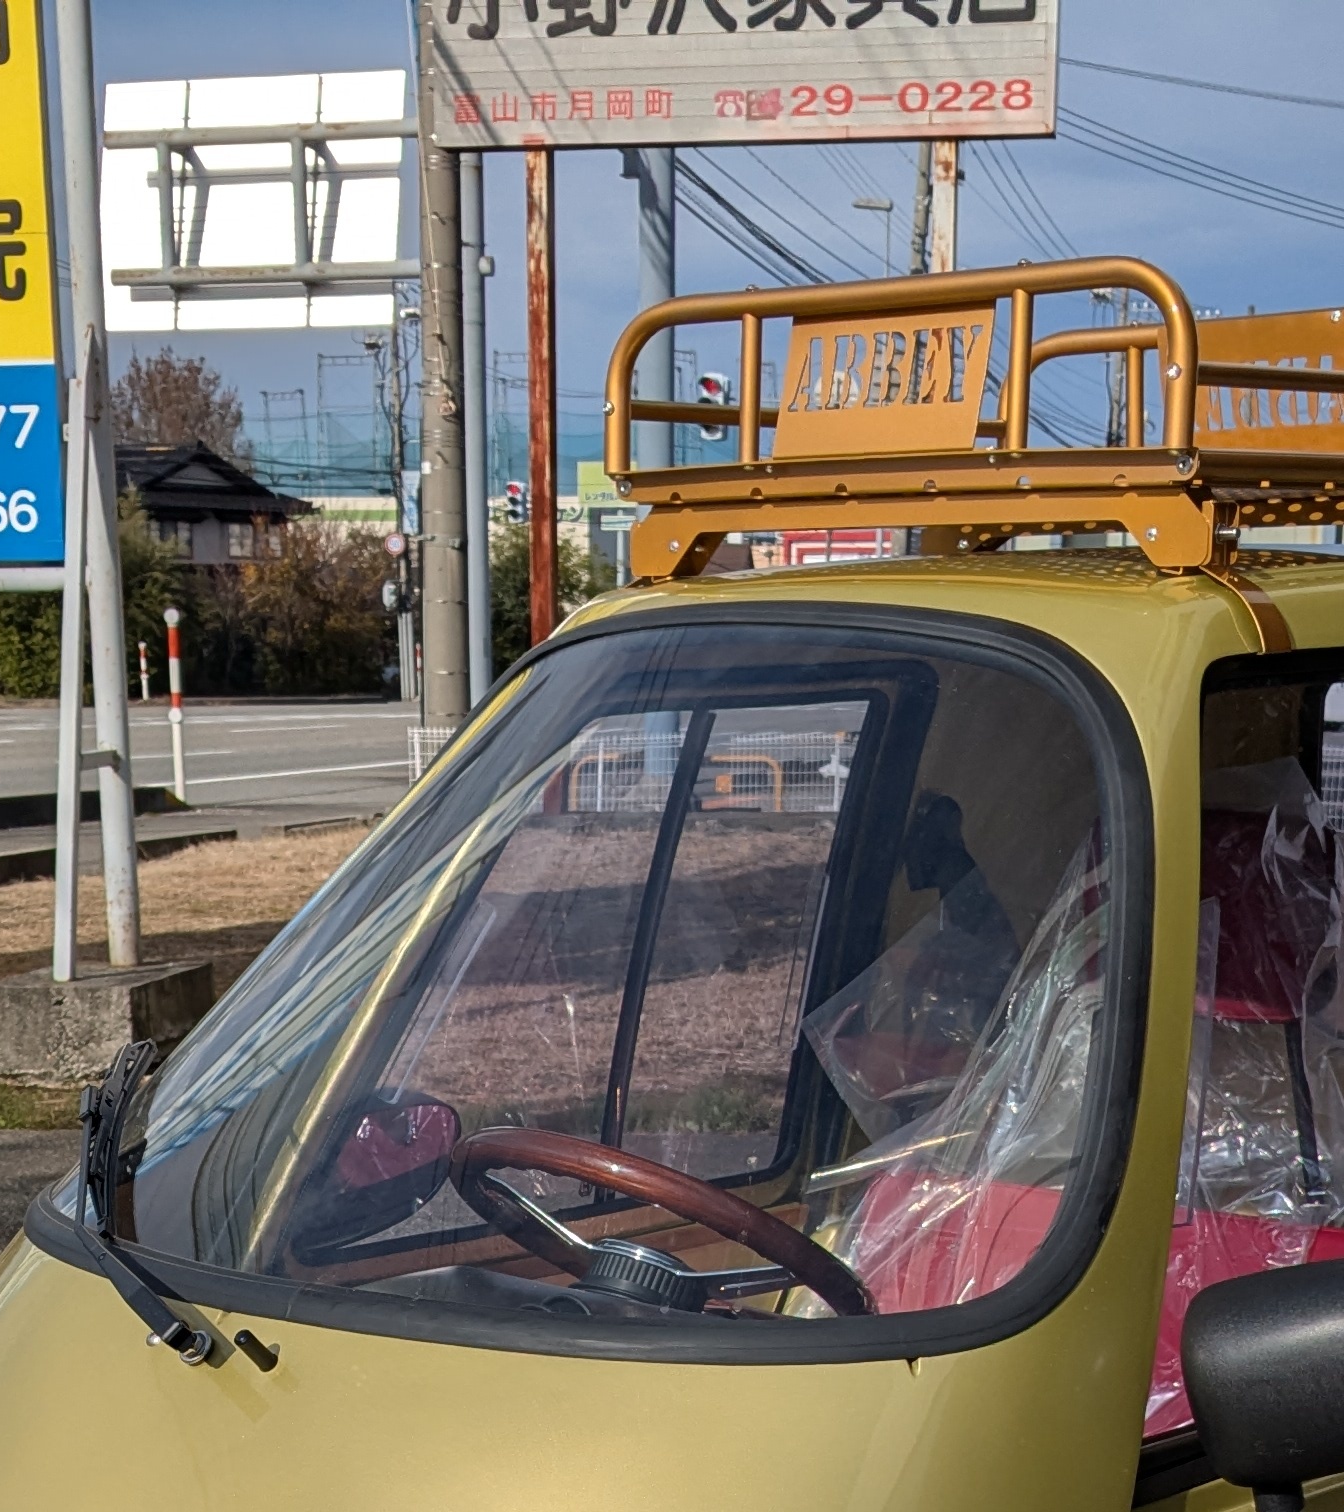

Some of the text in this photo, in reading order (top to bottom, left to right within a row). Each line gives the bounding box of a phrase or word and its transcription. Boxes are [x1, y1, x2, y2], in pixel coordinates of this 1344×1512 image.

[453, 88, 673, 124] 富山市月岡町
[788, 325, 983, 412] ABBEY
